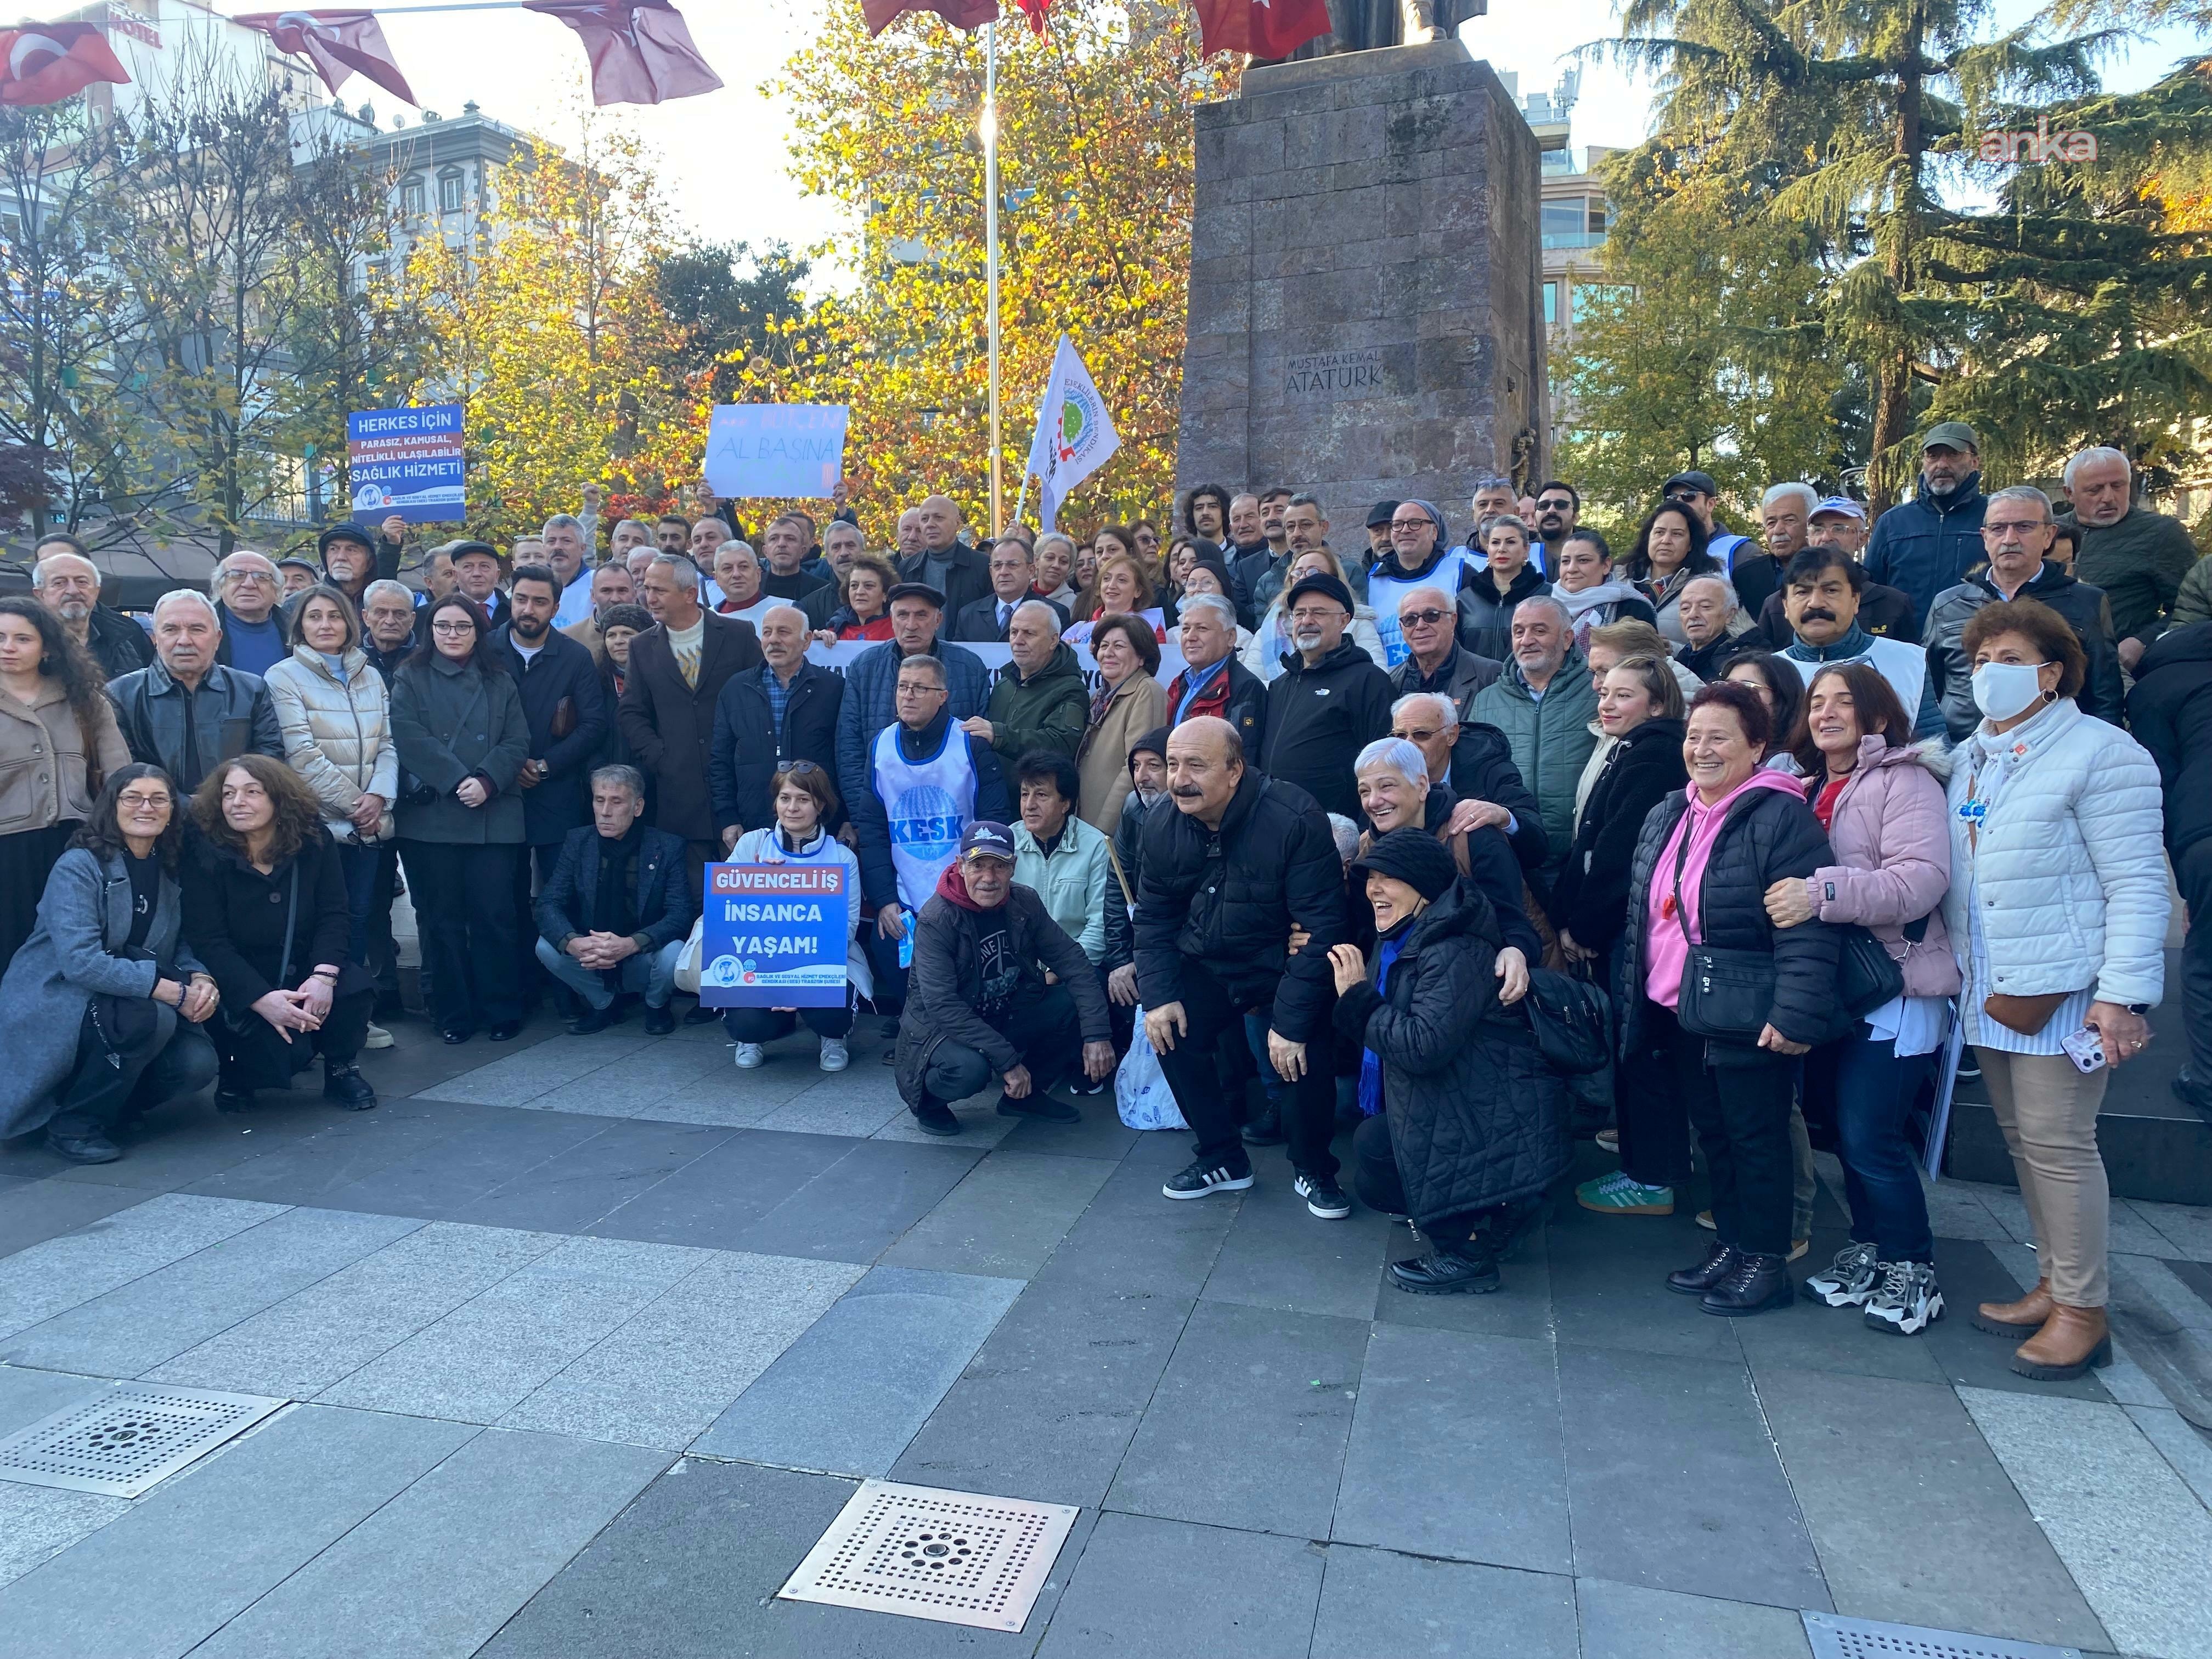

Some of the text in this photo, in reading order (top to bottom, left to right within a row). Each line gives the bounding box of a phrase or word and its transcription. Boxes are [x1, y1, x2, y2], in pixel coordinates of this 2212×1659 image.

[1288, 351, 1381, 369] MUSTAFA KEMAL
[1285, 364, 1383, 393] ATATÜRK
[358, 411, 452, 433] HERKES İÇİN
[360, 435, 452, 449] PARASIZ, KAMUSAL,
[716, 437, 749, 459] AL
[352, 447, 461, 464] NİTELİKLİ, ULAŞILABİLİR
[352, 459, 460, 482] SAĞLIK HİZMETİ
[888, 815, 964, 843] KESK
[716, 869, 838, 891] GÜVENCELİ İŞ
[725, 899, 822, 922] İNSANCA
[732, 936, 817, 958] YAŞAM!
